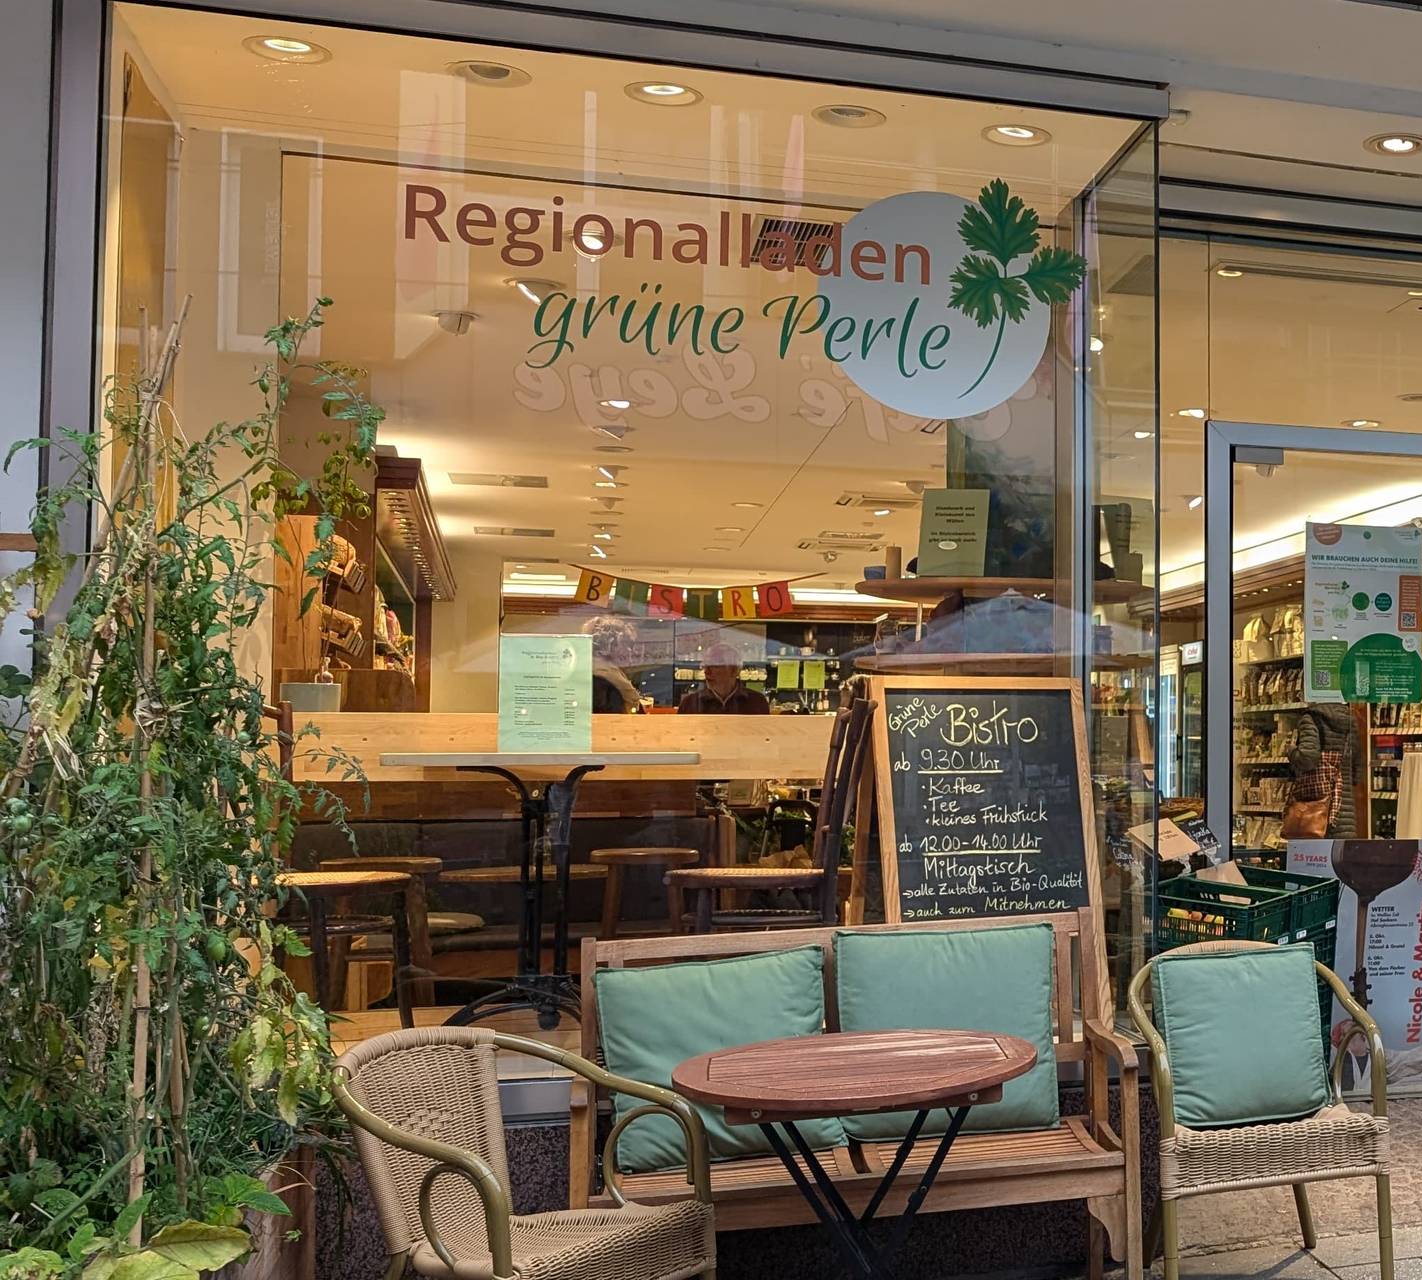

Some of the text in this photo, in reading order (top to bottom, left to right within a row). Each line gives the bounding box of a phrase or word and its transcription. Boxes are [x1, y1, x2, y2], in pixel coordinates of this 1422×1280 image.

[404, 183, 931, 285] Regionalladen
[525, 283, 951, 378] grüne Perle
[1326, 555, 1360, 563] BRAUCHEN
[586, 575, 784, 618] BISTRO
[888, 697, 1039, 747] Grüne Bistro
[900, 703, 943, 739] Perle
[893, 748, 1000, 772] ab 9.30 Uhr
[928, 777, 985, 796] Kaffee
[928, 795, 960, 813] Tee
[931, 801, 1048, 827] kleines Frühstück
[898, 834, 913, 853] ab
[1012, 832, 1043, 850] Uhr
[923, 854, 1035, 887] Mittagstisch
[1294, 854, 1328, 863] 25 YEARS
[913, 871, 1083, 896] alle Zutaten in Bio-Qualität
[916, 893, 1071, 917] auch zum Mitnehmen
